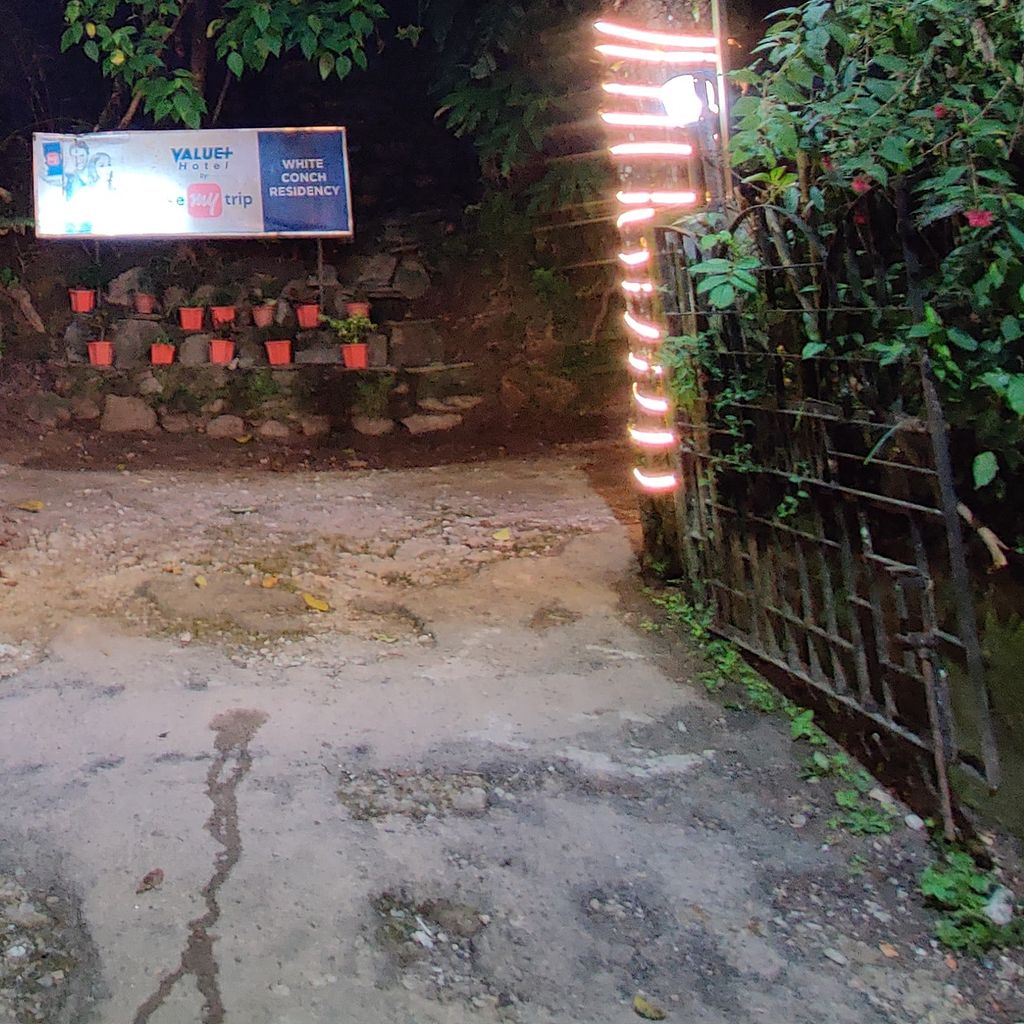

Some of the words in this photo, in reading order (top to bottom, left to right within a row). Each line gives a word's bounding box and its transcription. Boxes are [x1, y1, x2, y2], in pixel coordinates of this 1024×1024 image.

[178, 161, 228, 170] Hotel
[282, 158, 324, 169] WHITE
[281, 172, 327, 183] CONCH
[269, 185, 340, 196] RESIDENCY
[224, 191, 252, 208] trip
